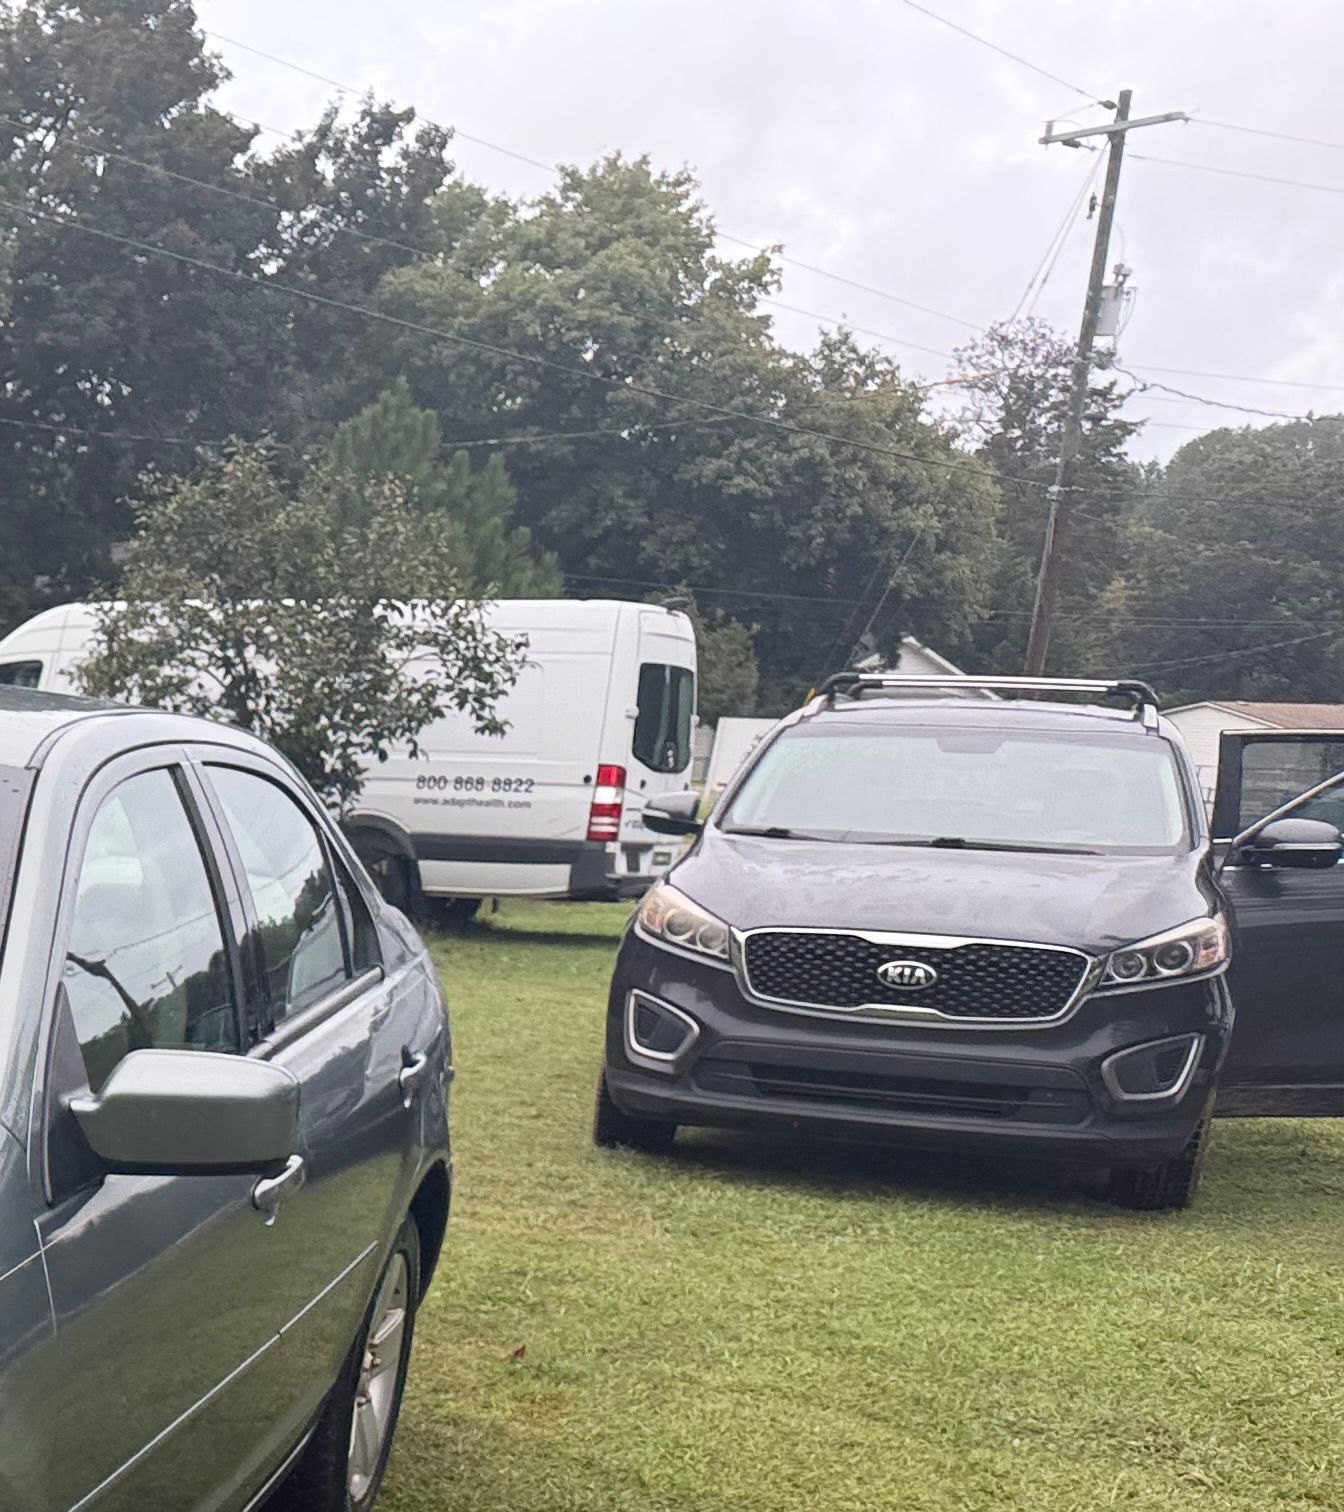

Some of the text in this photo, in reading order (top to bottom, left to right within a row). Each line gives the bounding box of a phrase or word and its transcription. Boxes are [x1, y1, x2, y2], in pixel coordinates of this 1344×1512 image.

[416, 774, 535, 793] 800 868 8822
[886, 966, 927, 985] KIA
